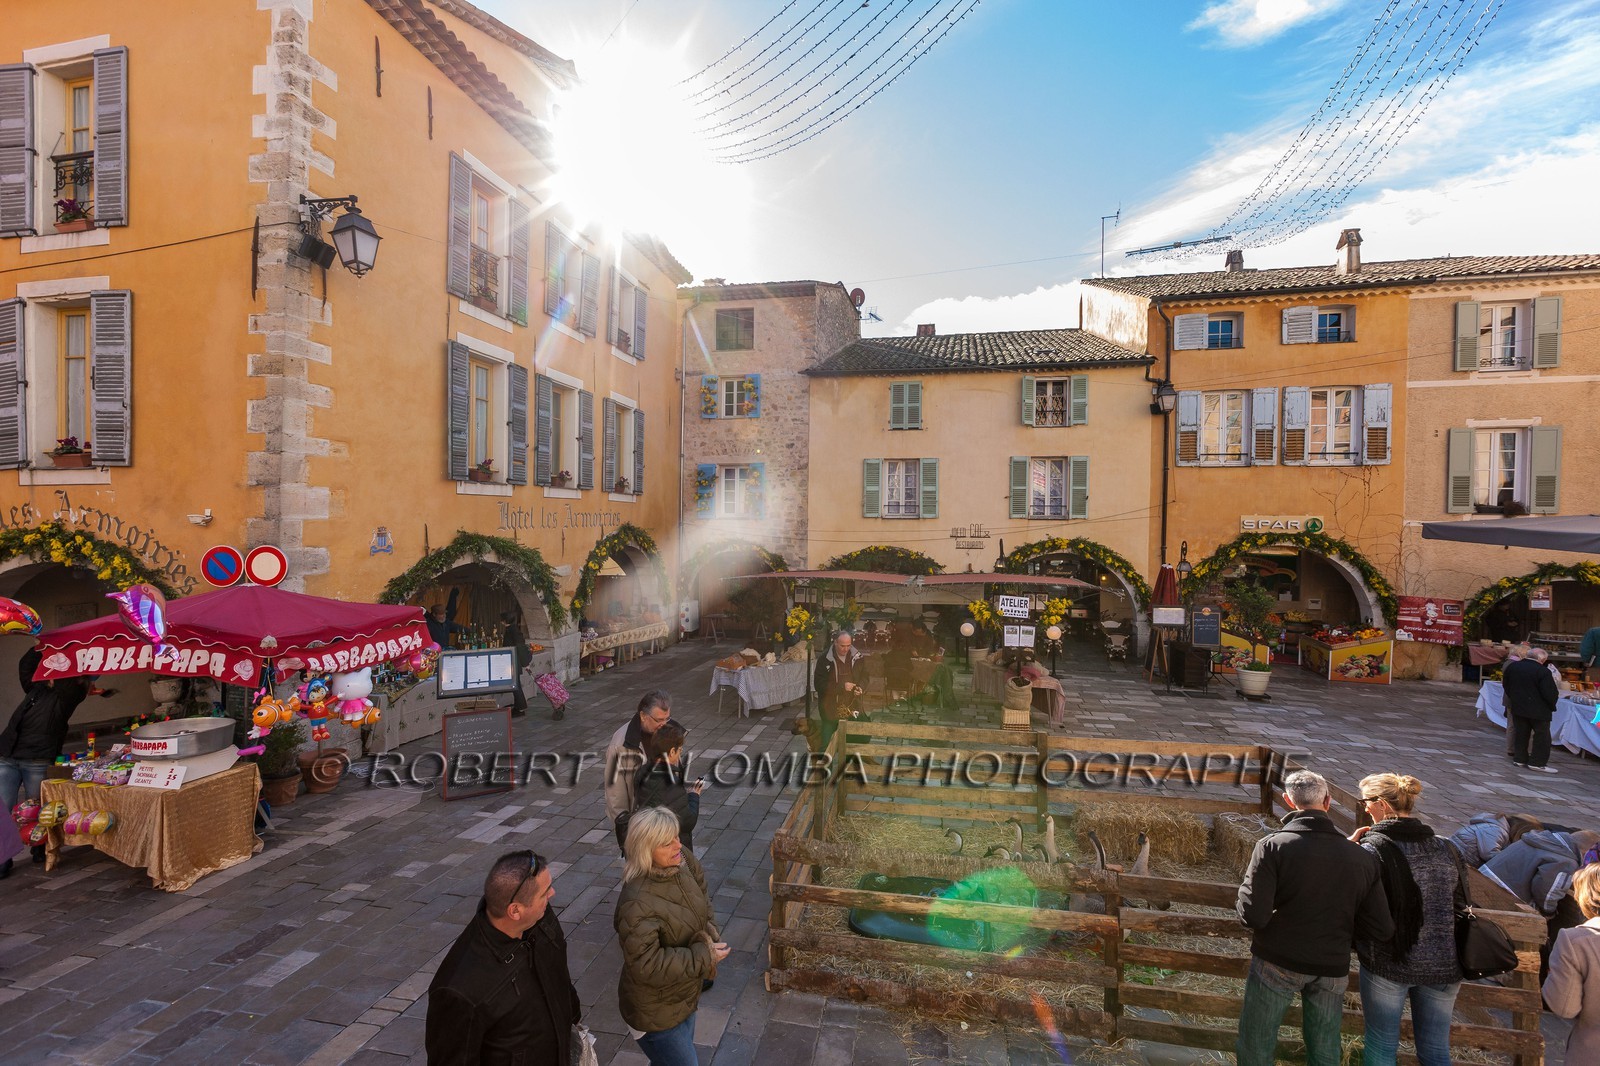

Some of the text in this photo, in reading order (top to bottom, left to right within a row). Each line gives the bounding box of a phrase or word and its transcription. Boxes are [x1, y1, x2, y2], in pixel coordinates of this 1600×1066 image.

[540, 507, 558, 529] les
[563, 504, 621, 528] Armoiries
[1243, 519, 1300, 530] SPAR
[1000, 597, 1029, 609] ATELIER
[307, 630, 423, 673] BARBAPAPA
[76, 645, 226, 677] BARBAPAPA
[132, 741, 168, 751] BARBAPAPA
